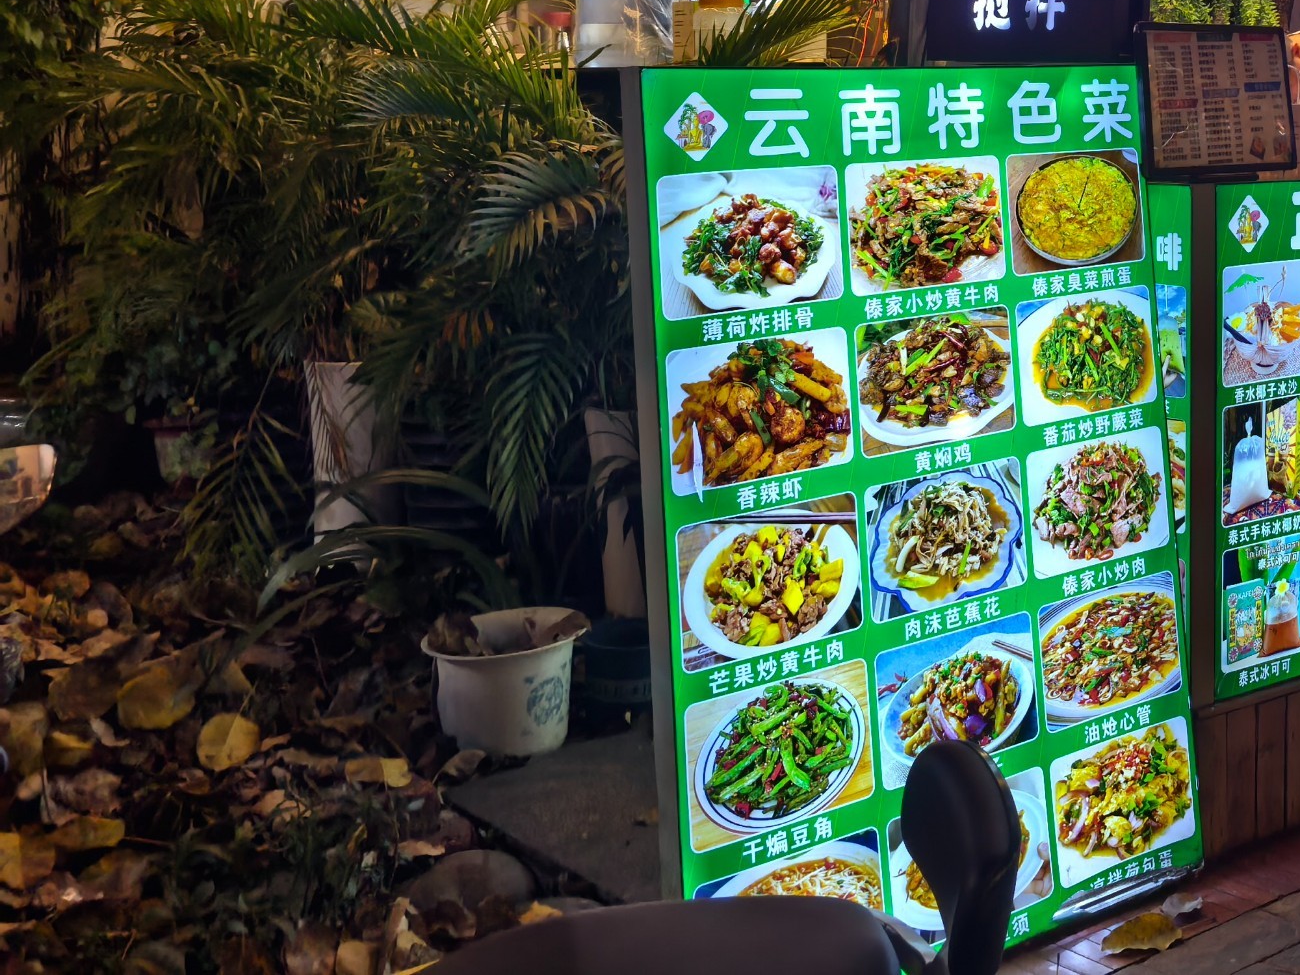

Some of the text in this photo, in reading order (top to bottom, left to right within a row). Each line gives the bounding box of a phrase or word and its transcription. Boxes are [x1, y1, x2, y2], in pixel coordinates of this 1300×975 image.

[744, 78, 1134, 159] 云南特色菜
[1031, 266, 1132, 297] 傣家臭菜煎蛋
[864, 283, 1000, 319] 傣家小炒黄牛肉
[702, 308, 815, 341] 薄荷炸排骨
[1234, 379, 1298, 404] 香水椰子冰沙
[1042, 408, 1145, 447] 番茄炒野蕨菜
[914, 443, 972, 474] 黄焖鸡
[736, 476, 803, 511] 香辣虾
[1061, 556, 1147, 597] 傣家小炒肉
[905, 595, 1001, 641] 肉沫芭蕉花
[708, 638, 845, 694] 芒果炒黄牛肉
[1238, 657, 1291, 688] 泰式冰可可
[742, 816, 833, 864] 干煸豆角
